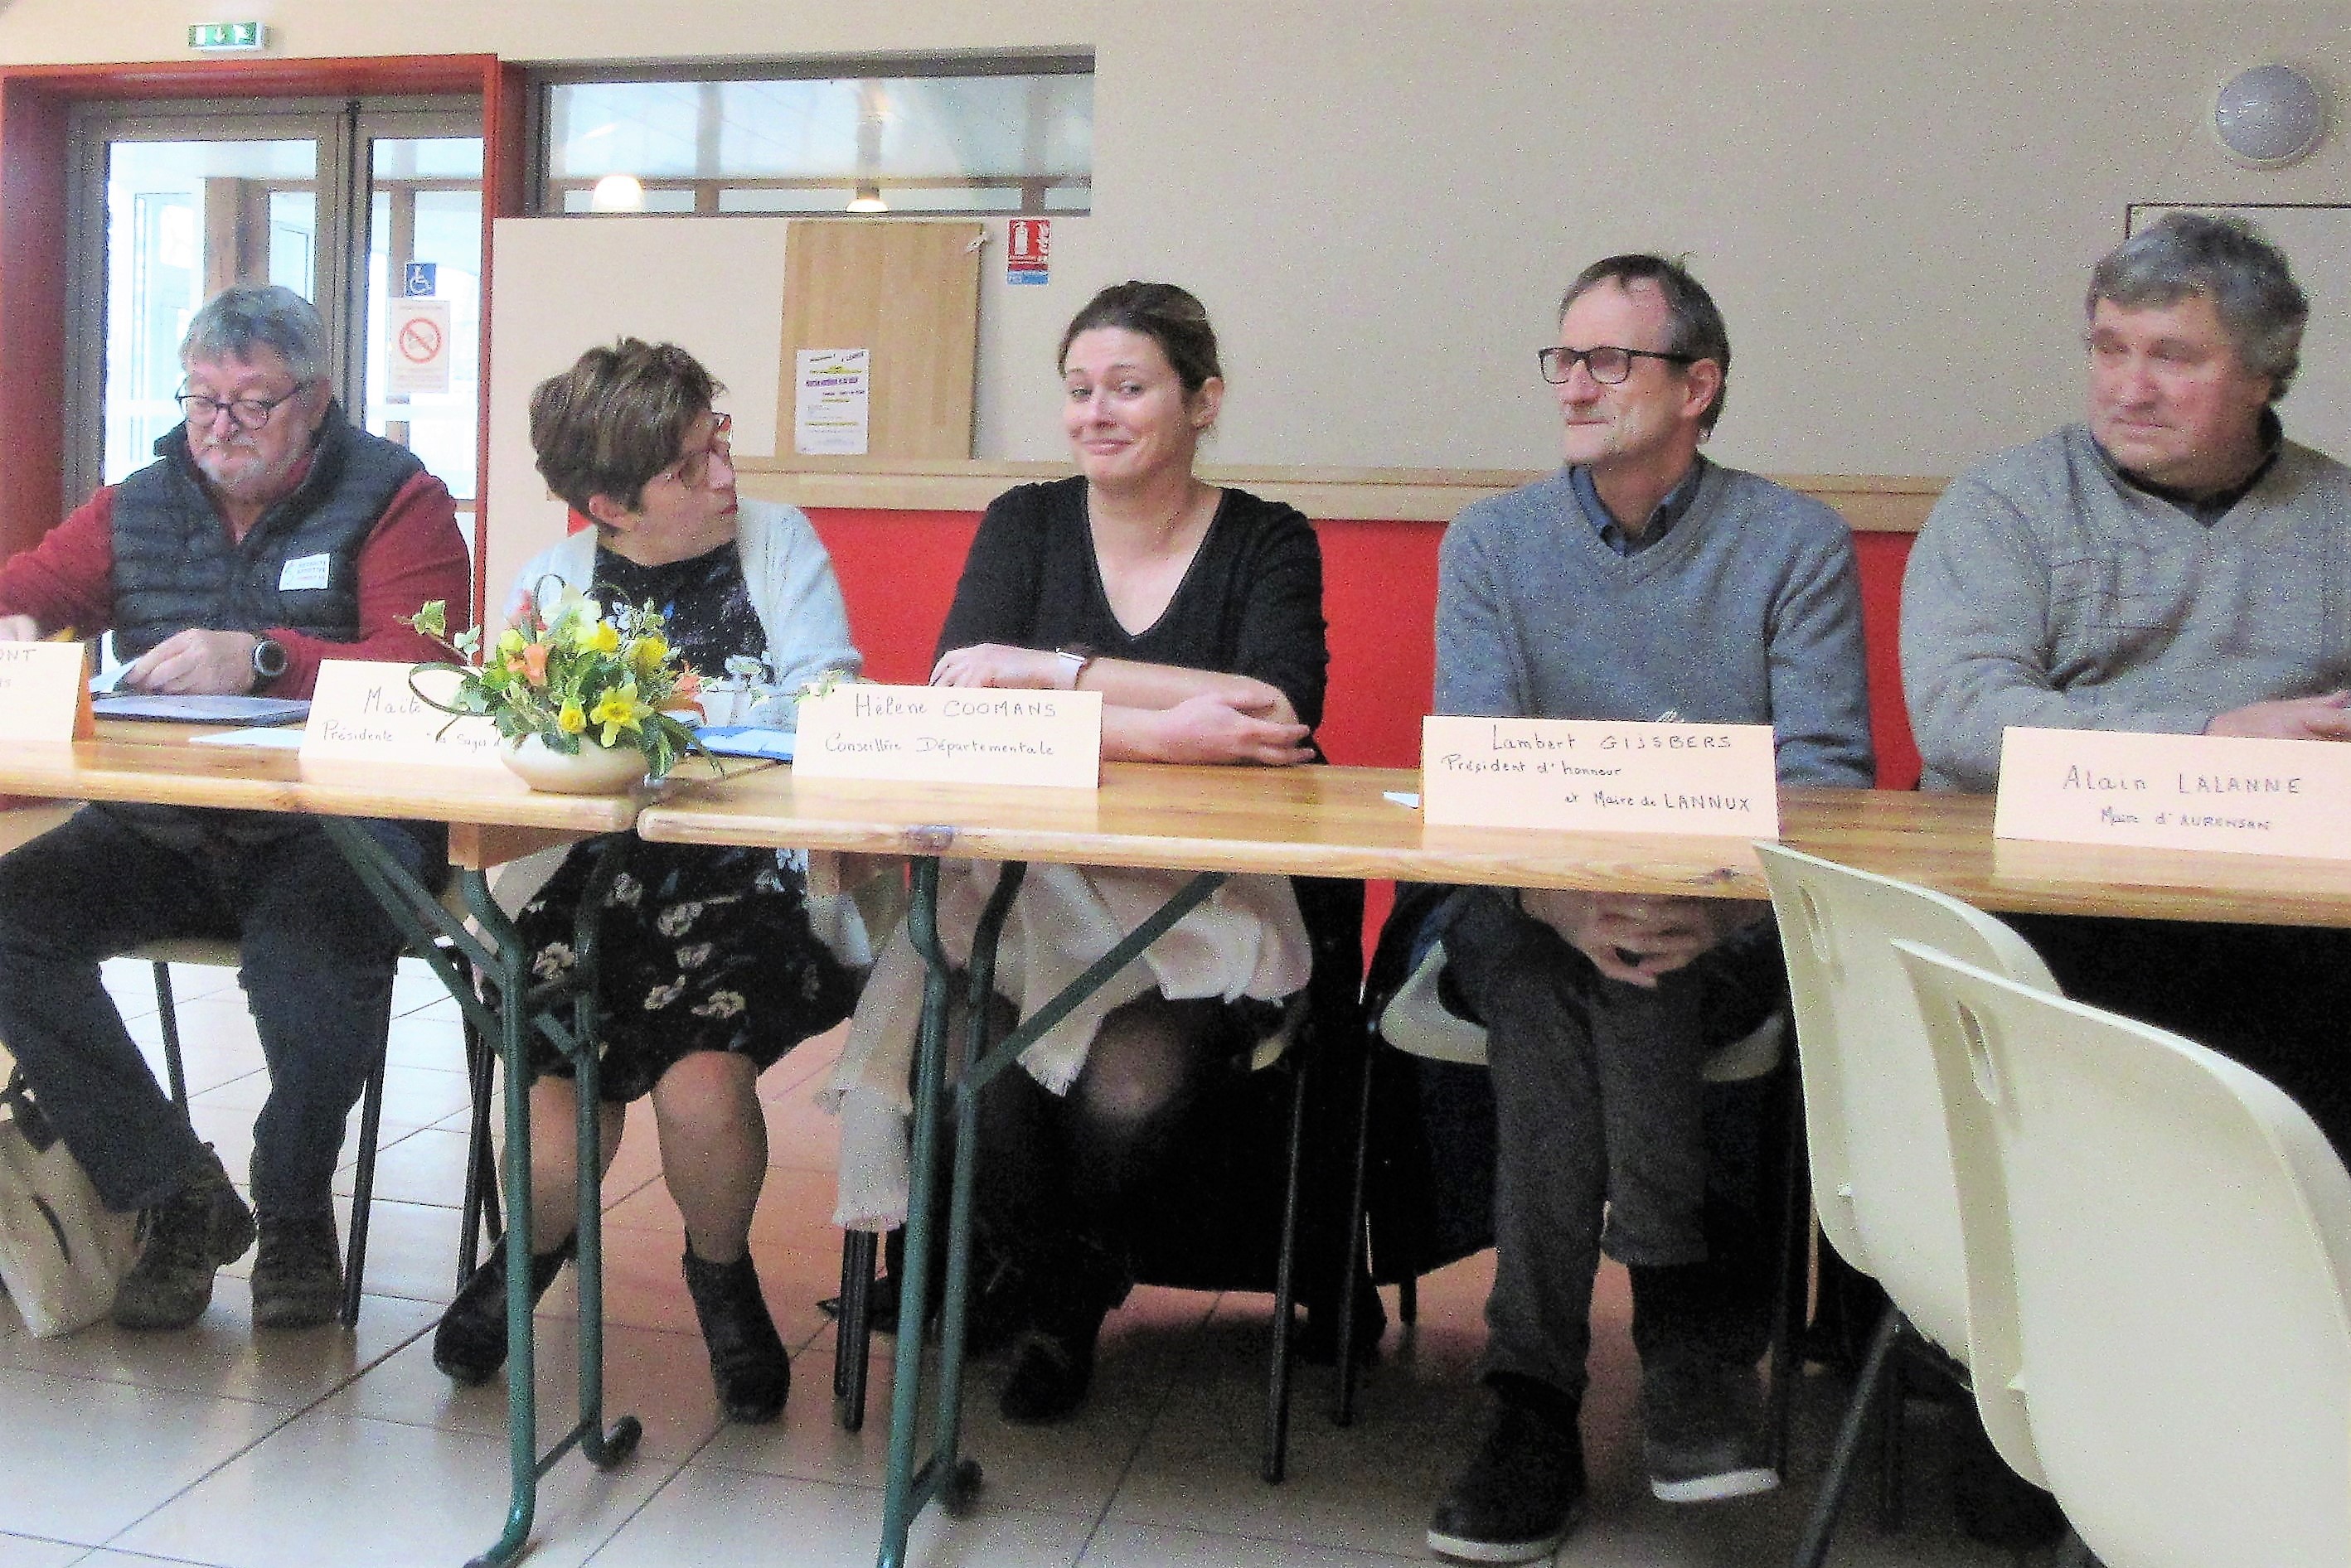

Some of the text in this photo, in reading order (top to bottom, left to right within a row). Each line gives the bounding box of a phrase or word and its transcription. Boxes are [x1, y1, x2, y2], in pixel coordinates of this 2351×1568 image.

[856, 693, 1056, 718] Hélène COOMANS
[322, 719, 393, 742] Présidente
[1492, 724, 1576, 751] Lambert
[915, 736, 1054, 758] Départementale
[1441, 753, 1526, 774] Président
[2063, 764, 2302, 794] Alain LALANNE
[1594, 791, 1635, 807] Maire
[1640, 794, 1657, 806] de
[1664, 792, 1752, 813] LANNUX
